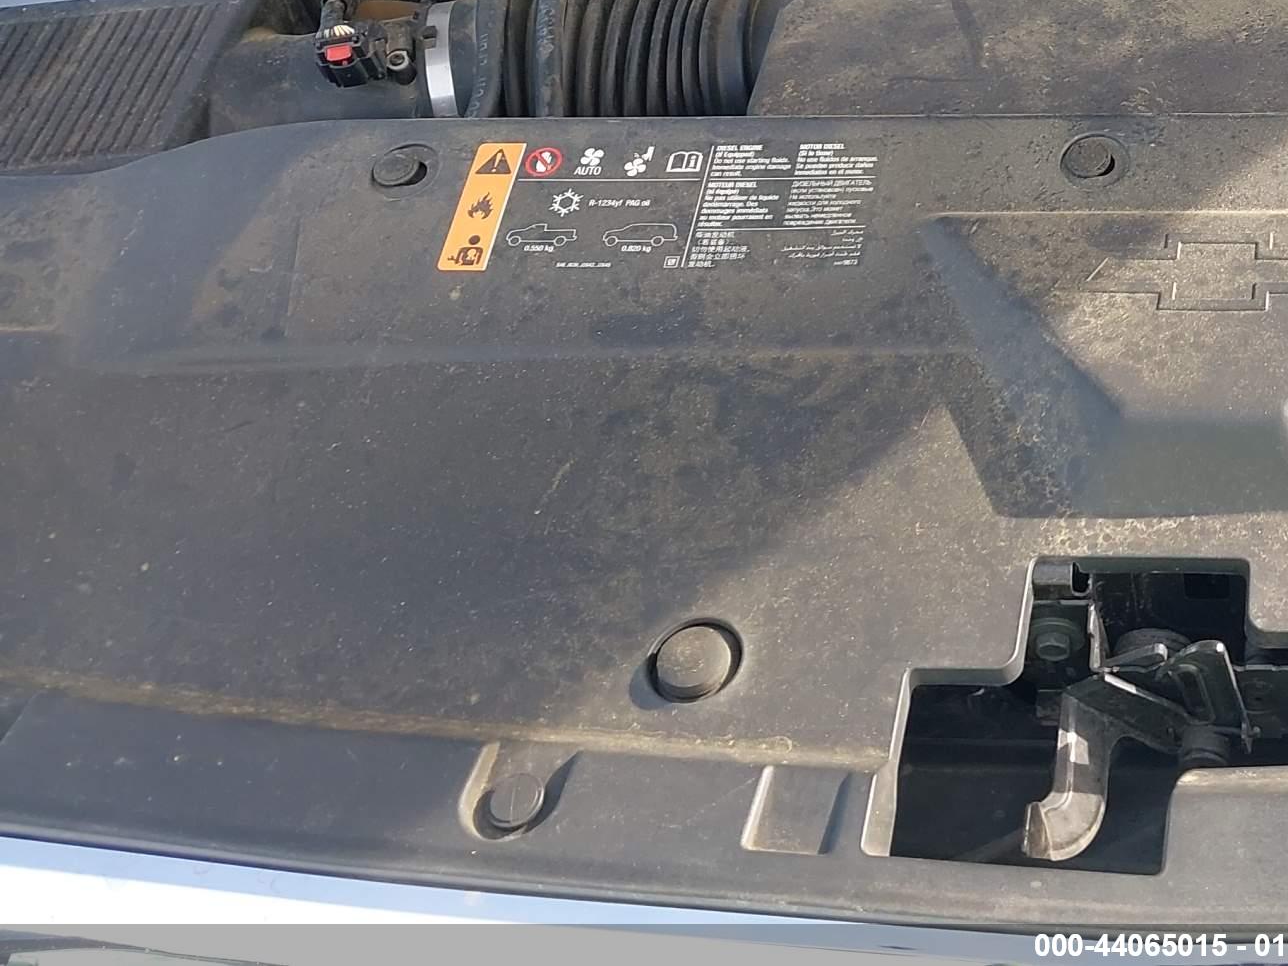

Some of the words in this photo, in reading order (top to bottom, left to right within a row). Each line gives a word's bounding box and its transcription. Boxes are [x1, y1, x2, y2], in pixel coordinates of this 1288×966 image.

[574, 166, 602, 176] AUTO
[588, 199, 623, 208] R-1234yf
[625, 199, 640, 207] PAG
[544, 245, 554, 253] kg
[643, 245, 652, 253] kg
